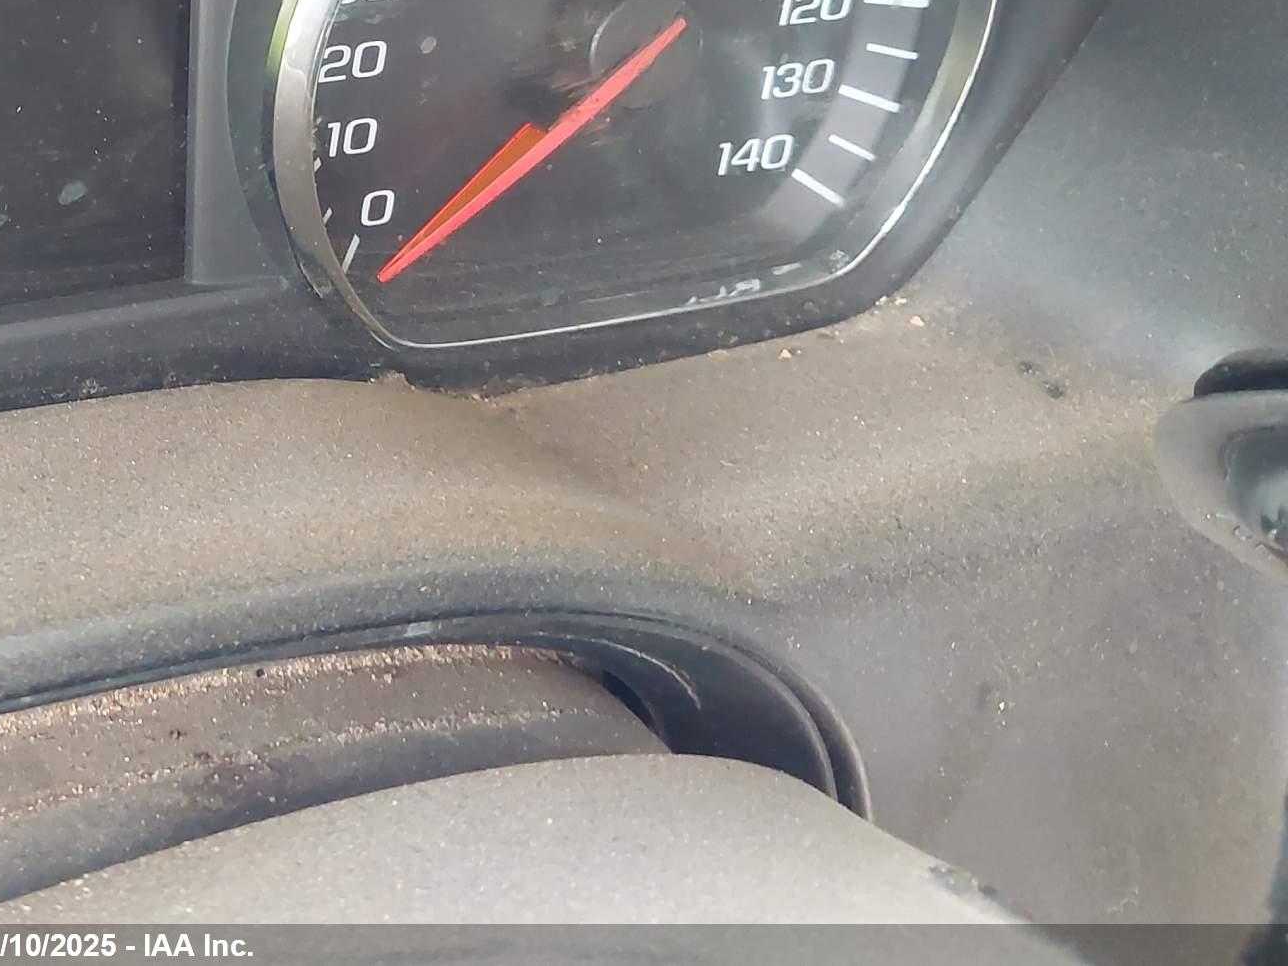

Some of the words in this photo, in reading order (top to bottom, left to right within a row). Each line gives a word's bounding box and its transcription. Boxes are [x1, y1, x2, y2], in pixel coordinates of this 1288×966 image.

[318, 40, 387, 83] 20
[761, 59, 835, 100] 130
[327, 118, 378, 157] 10
[717, 134, 794, 176] 140
[361, 190, 395, 226] 0
